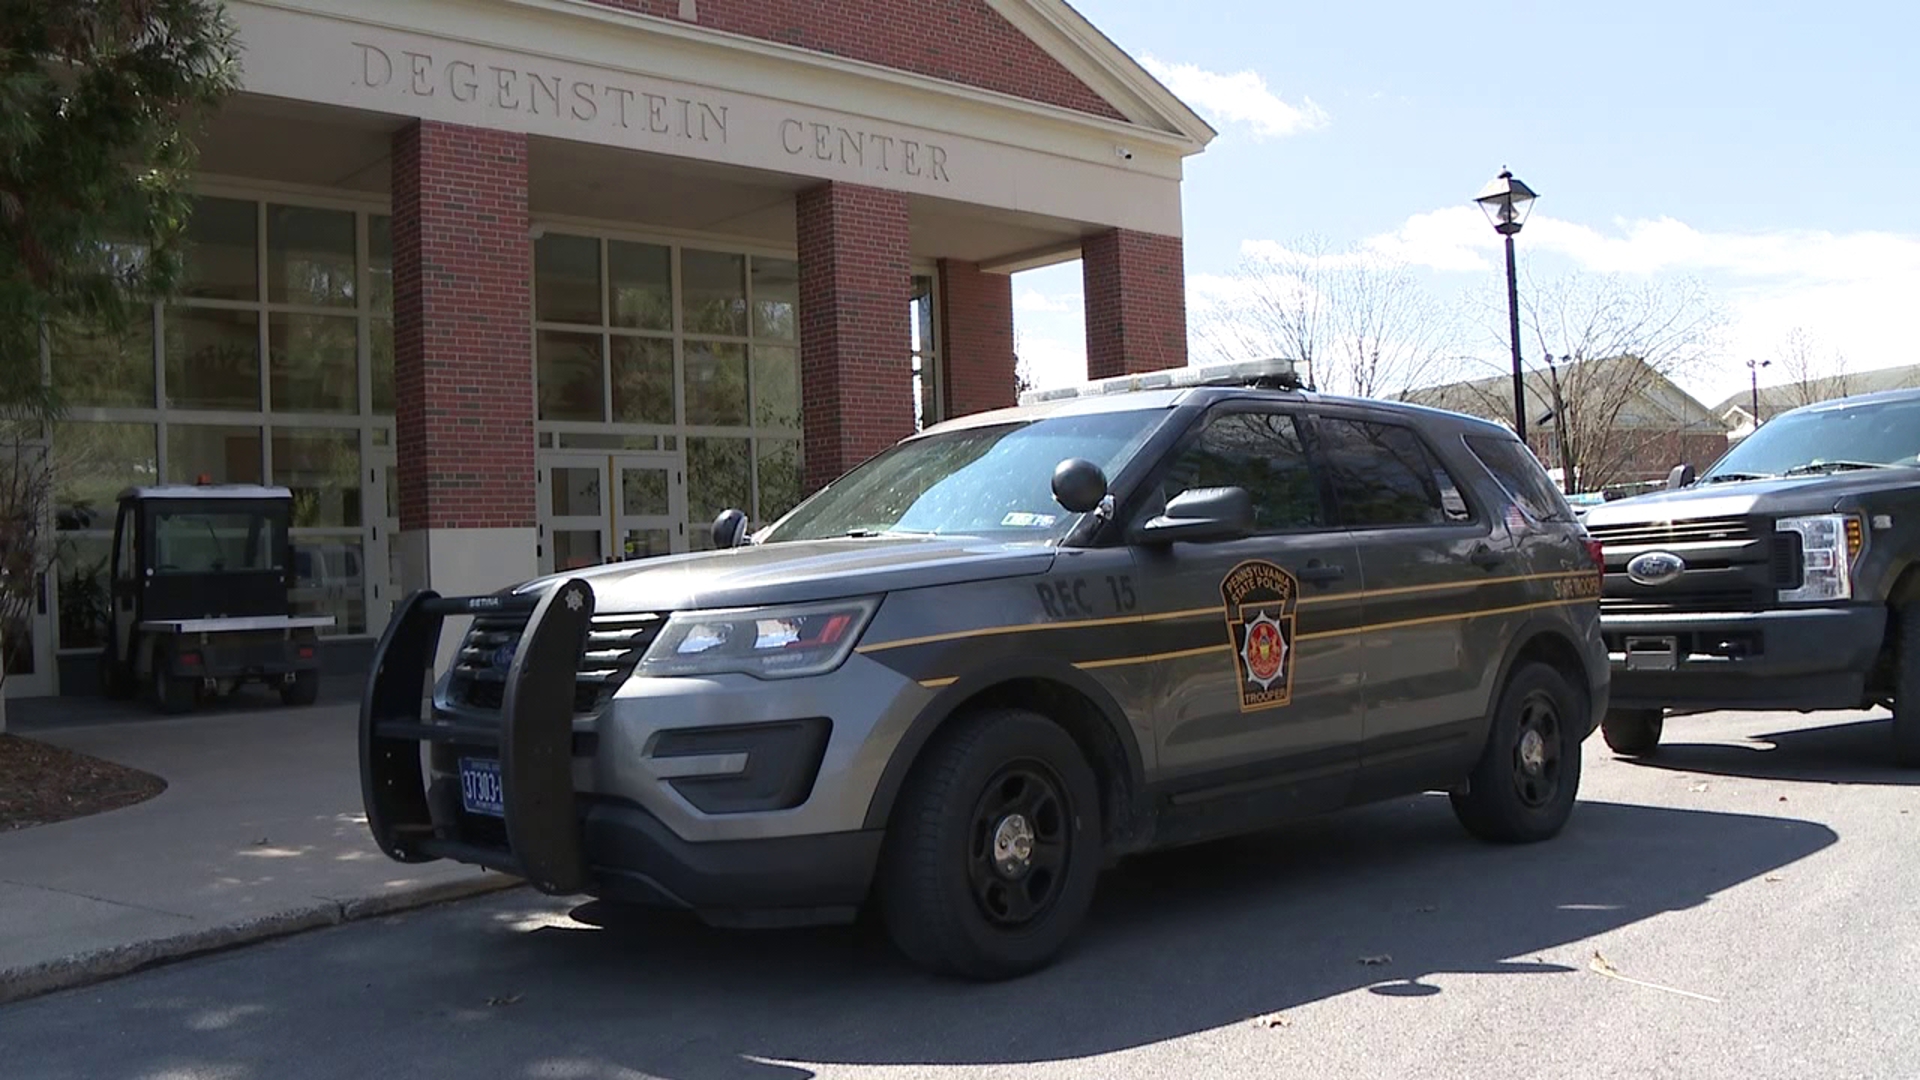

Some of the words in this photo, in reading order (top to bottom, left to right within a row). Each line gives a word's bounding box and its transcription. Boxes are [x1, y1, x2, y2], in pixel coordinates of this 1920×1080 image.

[351, 42, 728, 144] DEGENSTEIN
[781, 118, 950, 182] CENTER
[1226, 565, 1290, 593] PENNSYLVANIA
[1231, 579, 1256, 604] STATE
[1257, 577, 1289, 599] POLICE
[1035, 578, 1092, 618] REC
[1106, 575, 1136, 612] 15
[1245, 688, 1285, 704] TROOPER
